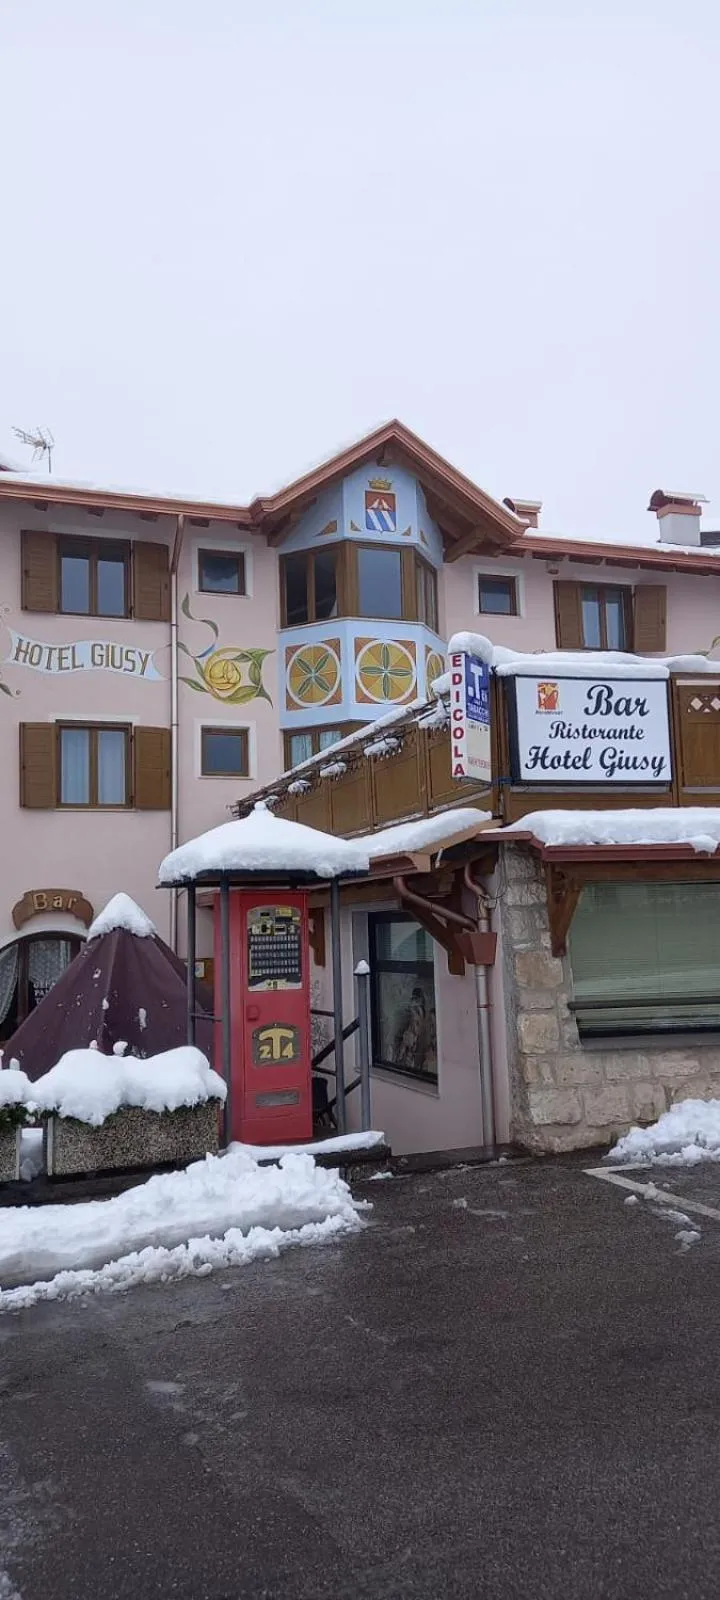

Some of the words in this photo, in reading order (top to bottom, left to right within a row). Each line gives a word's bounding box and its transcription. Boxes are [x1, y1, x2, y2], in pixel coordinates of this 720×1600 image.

[14, 637, 84, 670] HOTEL
[91, 643, 149, 675] GIUSY
[452, 655, 464, 776] EDICOLA
[584, 684, 650, 716] Bar
[549, 720, 645, 740] Ristorante
[525, 745, 592, 770] Hotel
[599, 746, 666, 777] Giusy
[33, 893, 77, 910] Bar
